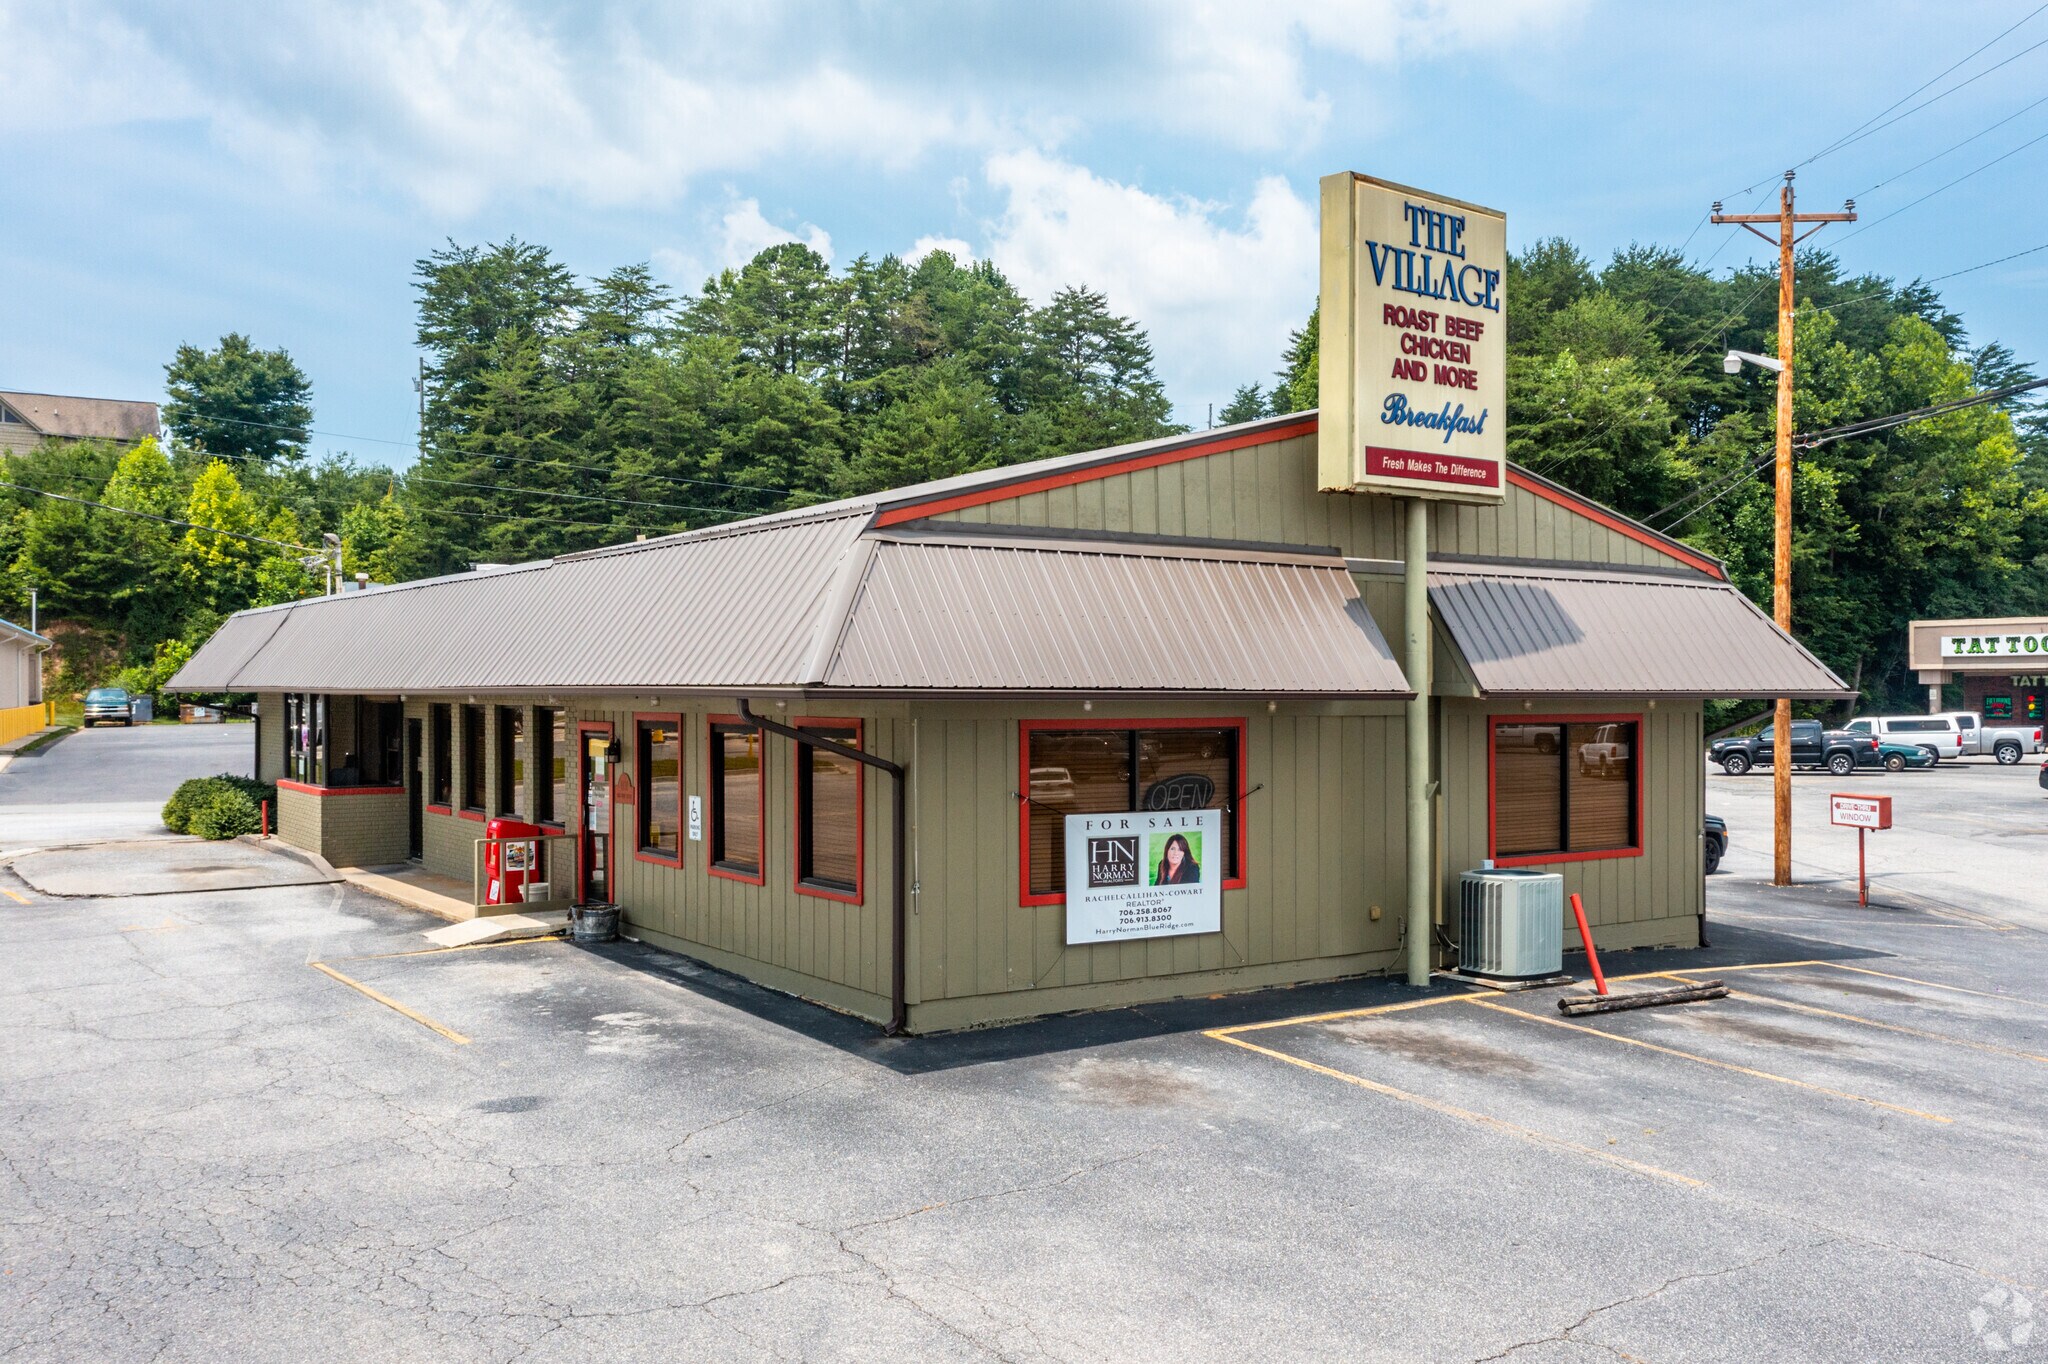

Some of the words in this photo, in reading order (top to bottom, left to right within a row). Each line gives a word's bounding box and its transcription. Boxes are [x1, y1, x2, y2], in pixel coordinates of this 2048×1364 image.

[1404, 200, 1466, 260] THE
[1365, 239, 1500, 313] VILLAGE
[1383, 303, 1439, 333] ROAST
[1445, 315, 1484, 342] BEEF
[1400, 332, 1471, 365] CHICKEN
[1391, 358, 1428, 382] AND
[1434, 367, 1478, 391] MORE
[1380, 392, 1489, 444] Breakfast
[1382, 456, 1405, 470] Fresh
[1407, 459, 1432, 473] Makes
[1435, 461, 1448, 475] The
[1450, 463, 1486, 479] Difference
[1151, 783, 1208, 811] OPEN
[1086, 819, 1130, 831] FOR
[1149, 816, 1204, 828] SALE
[1840, 812, 1871, 822] WINDOW
[1091, 839, 1136, 863] HN
[1092, 863, 1135, 873] HARRY
[1092, 870, 1135, 880] NORMAN
[1118, 906, 1172, 917] 706.258.8067
[1119, 914, 1172, 925] 706.913.8300
[1095, 922, 1194, 935] HarryNormanBlueRidge.com
